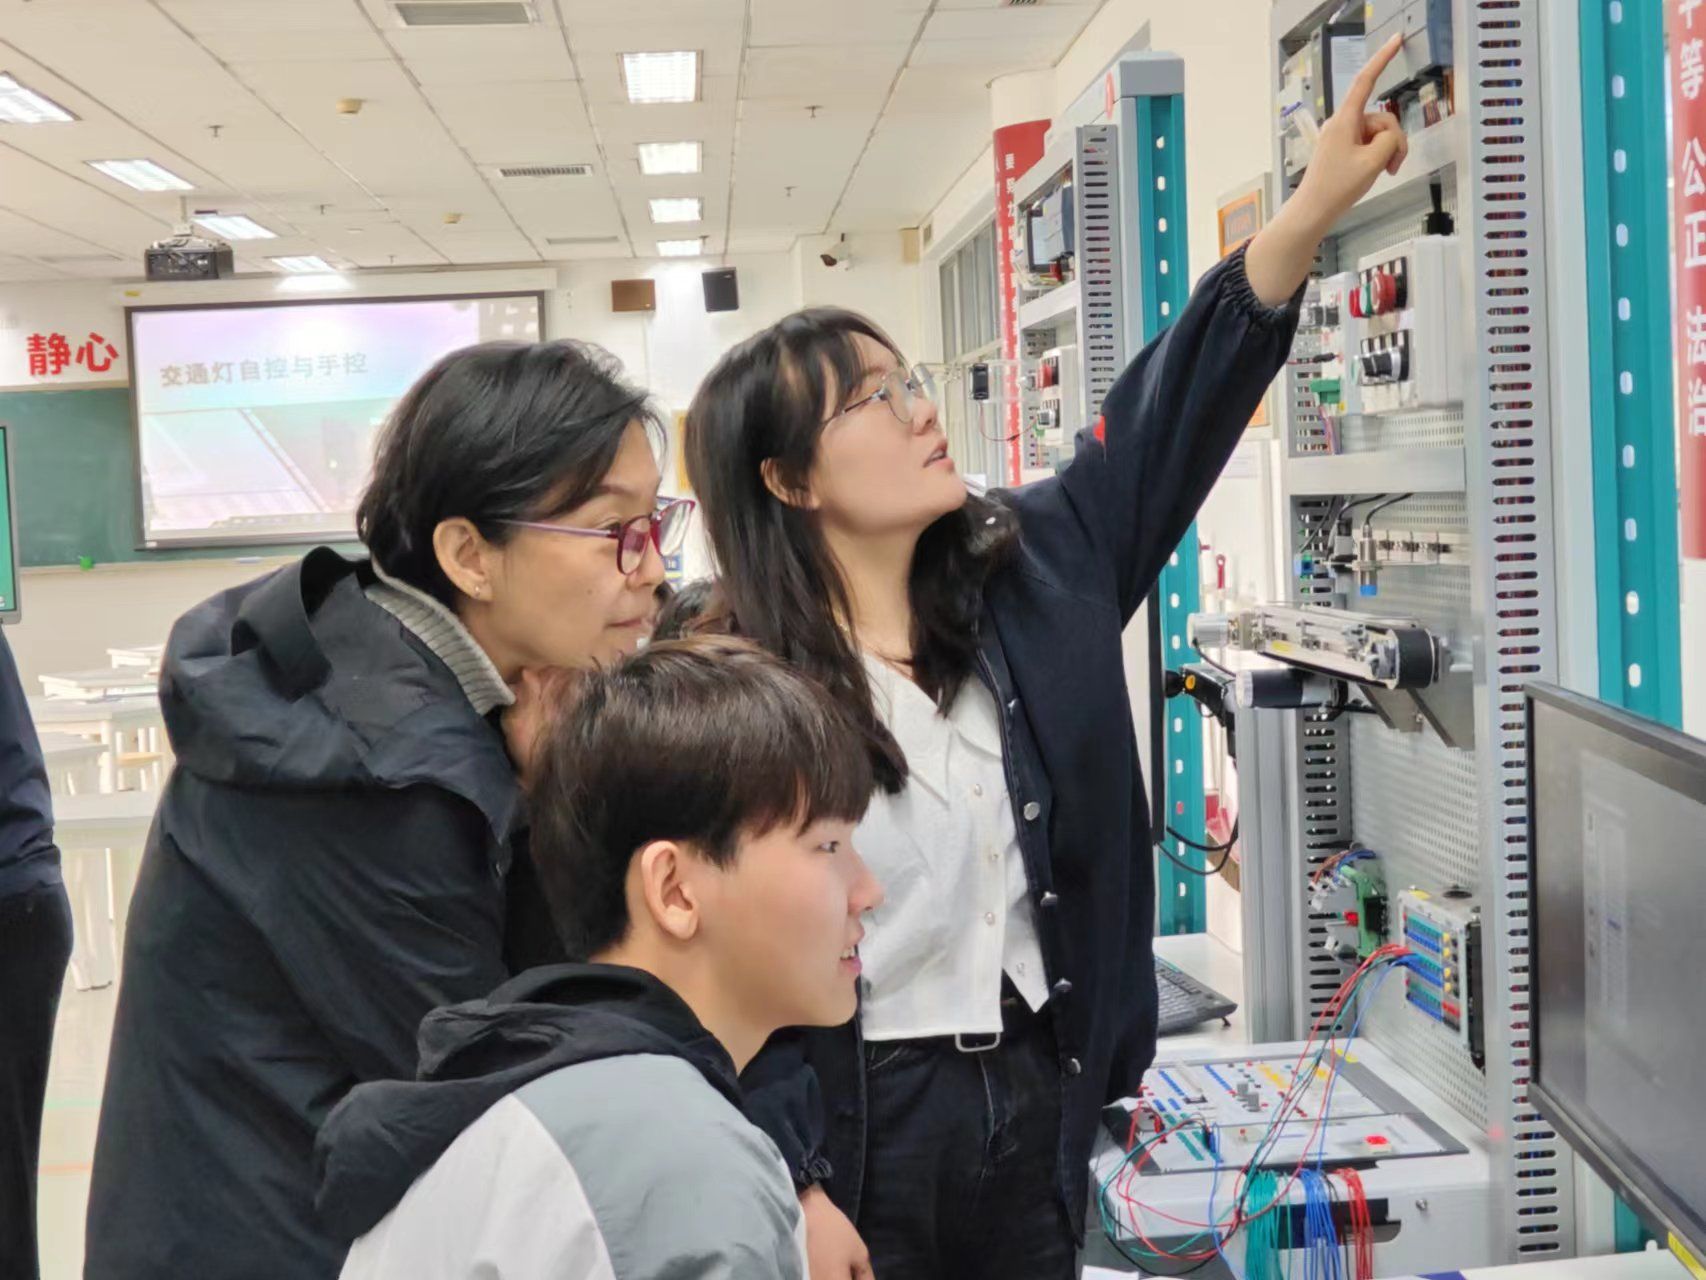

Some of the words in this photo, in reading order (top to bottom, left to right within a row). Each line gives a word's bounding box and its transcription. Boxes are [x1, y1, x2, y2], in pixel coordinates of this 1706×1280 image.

[1681, 136, 1706, 267] 公正
[27, 332, 119, 376] 静心
[160, 352, 369, 388] 交通灯自控与手控
